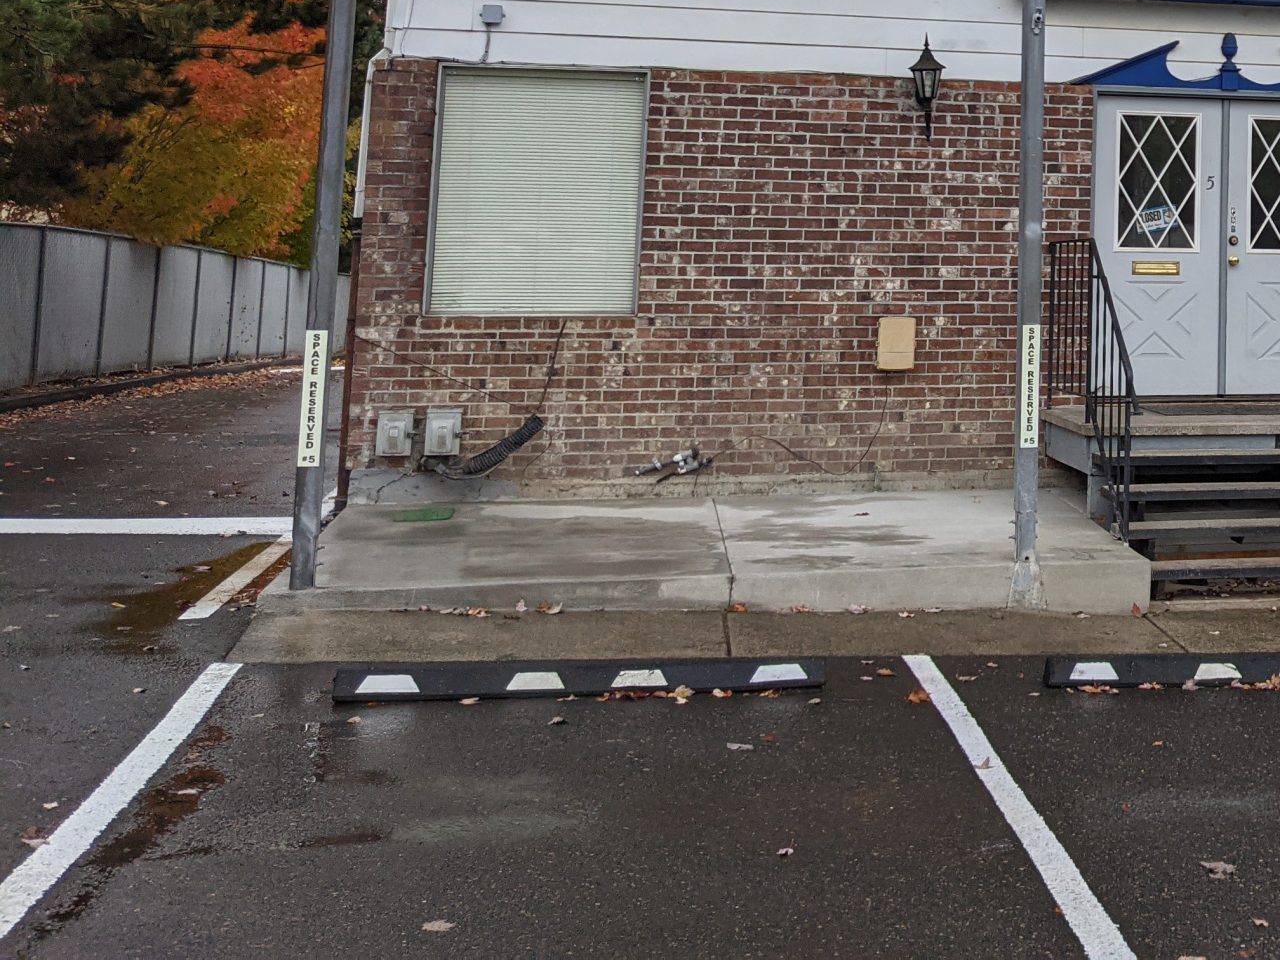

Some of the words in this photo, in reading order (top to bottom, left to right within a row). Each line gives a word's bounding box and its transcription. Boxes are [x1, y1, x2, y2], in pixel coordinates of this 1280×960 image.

[1205, 175, 1216, 191] 5
[310, 333, 321, 375] SPACE
[1027, 327, 1035, 365] SPACE
[305, 381, 318, 449] RESERVED
[1026, 370, 1035, 432] RESERVED
